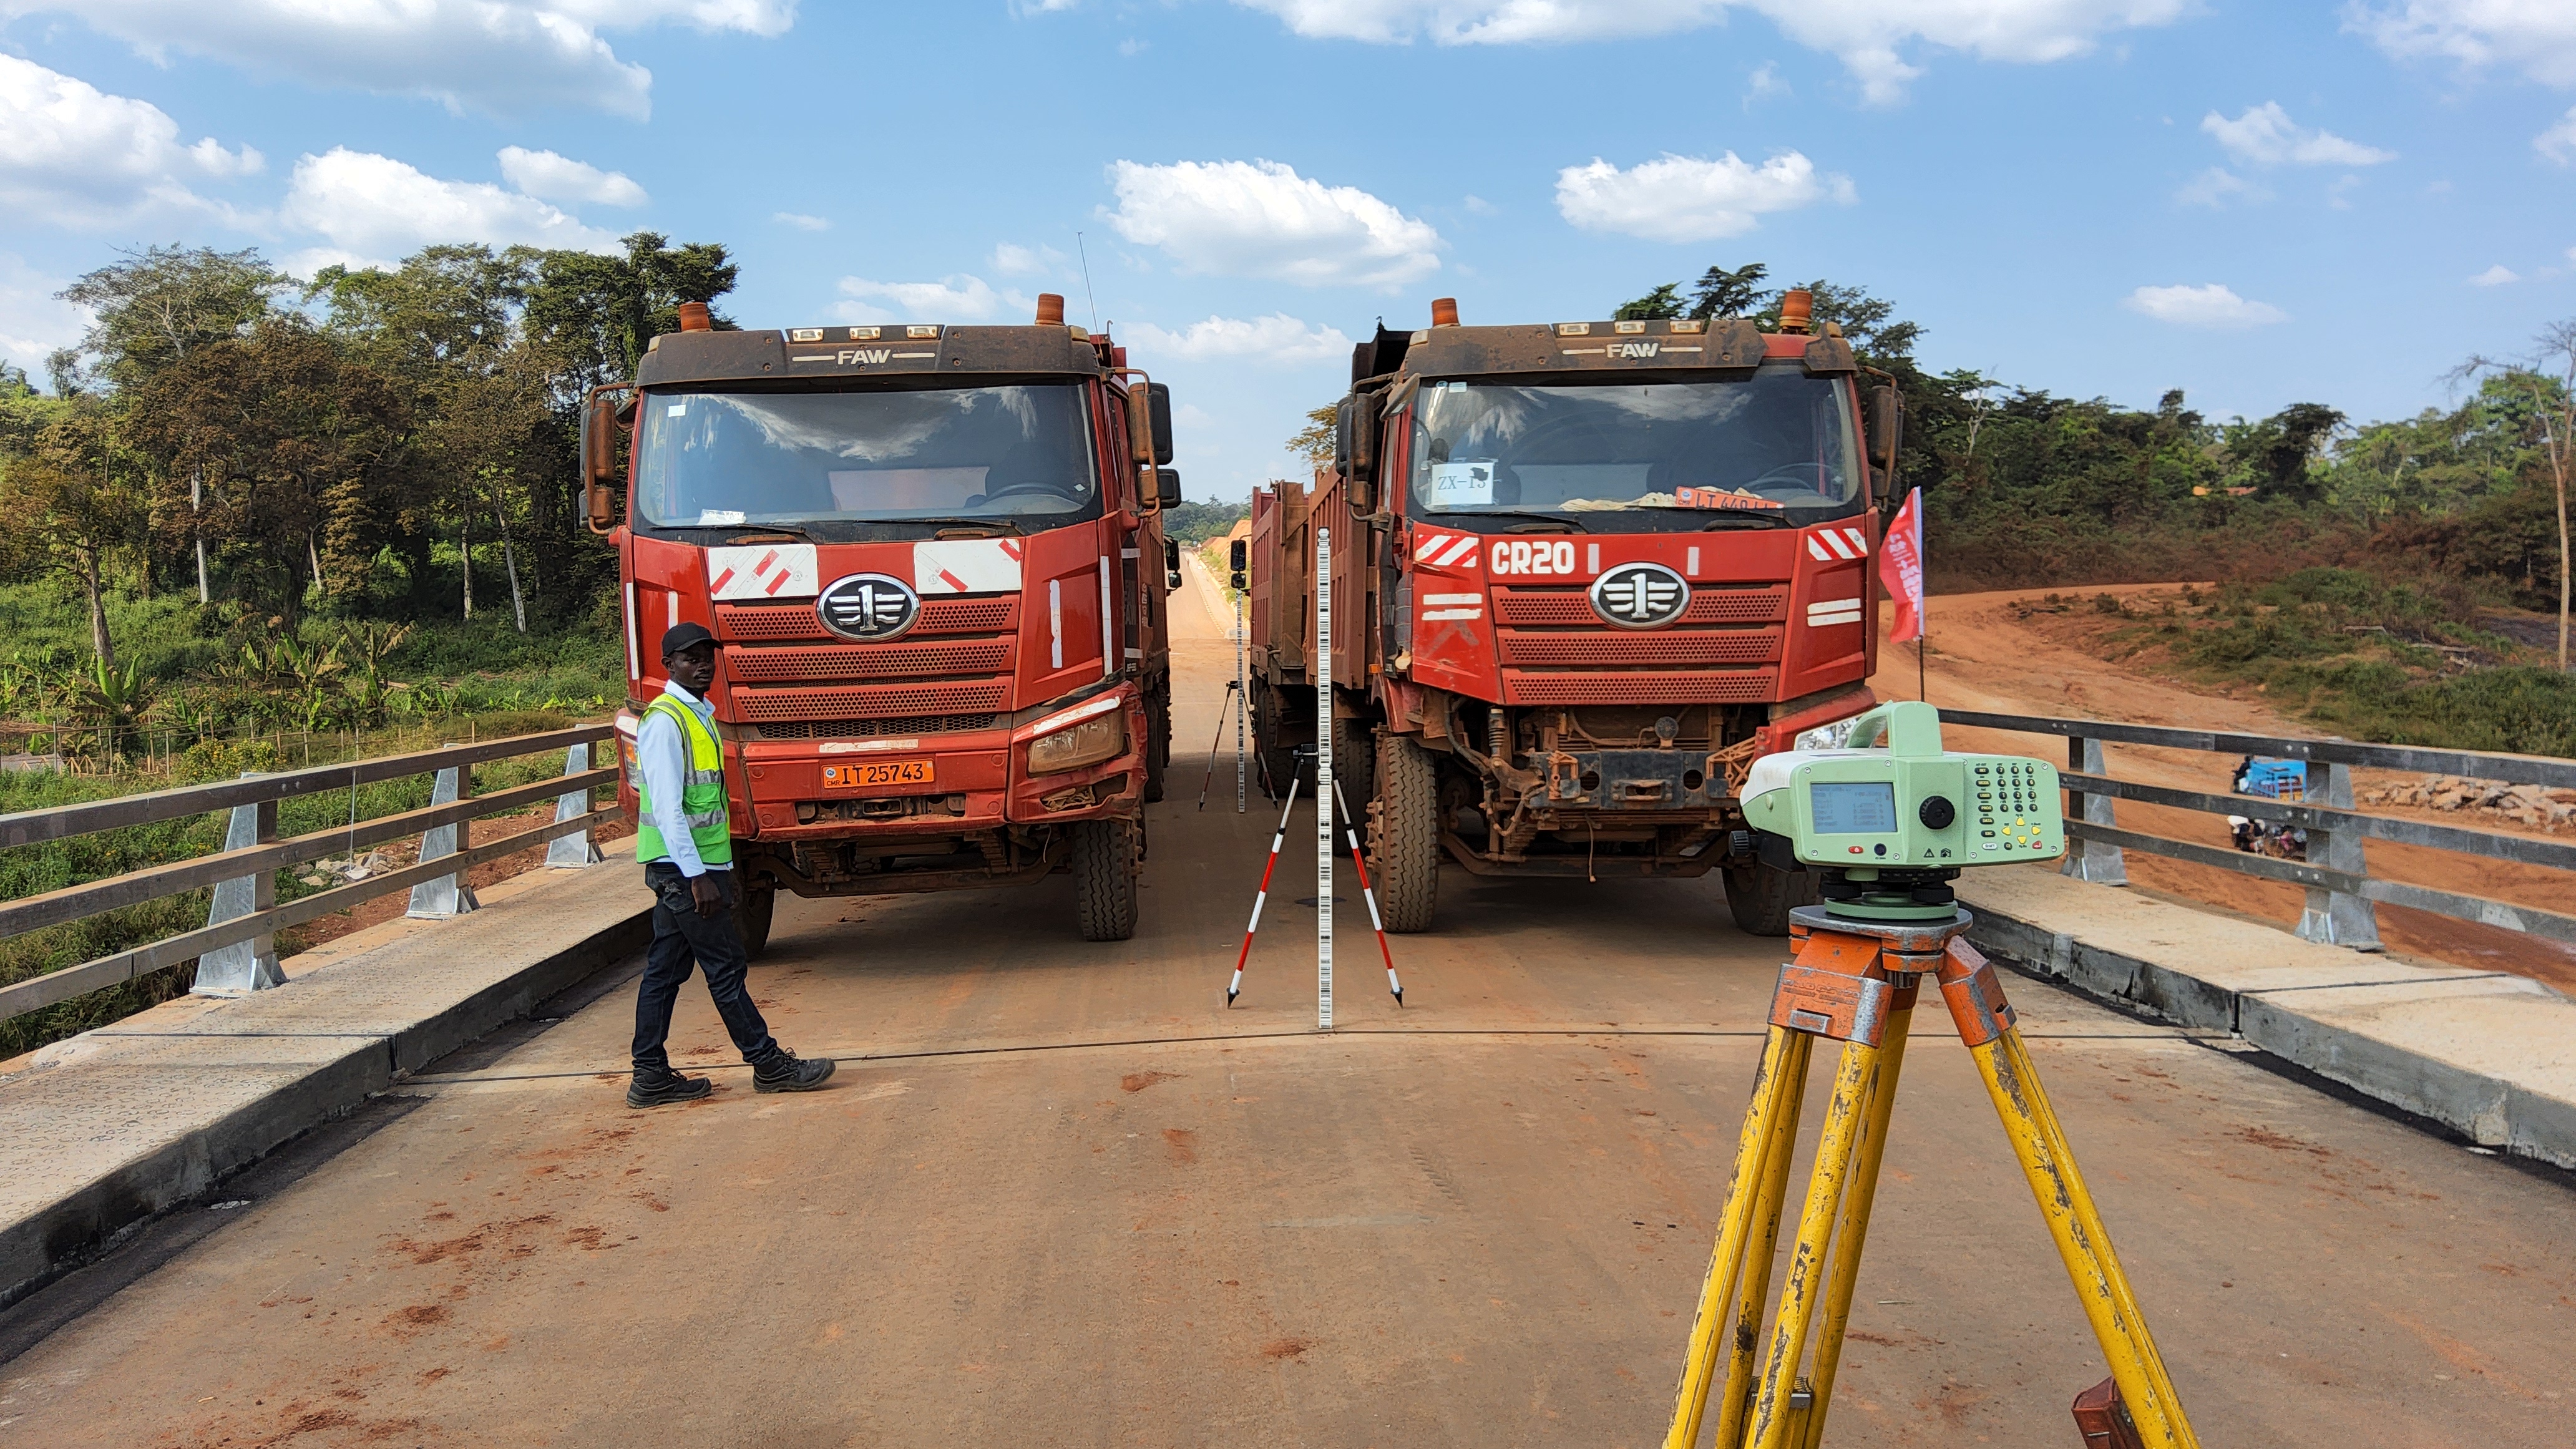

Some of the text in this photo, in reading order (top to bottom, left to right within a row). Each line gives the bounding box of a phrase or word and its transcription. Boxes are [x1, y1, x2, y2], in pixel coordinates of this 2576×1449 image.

[837, 349, 891, 365] FAW
[1606, 343, 1659, 358] FAW
[1491, 541, 1575, 574] CR20
